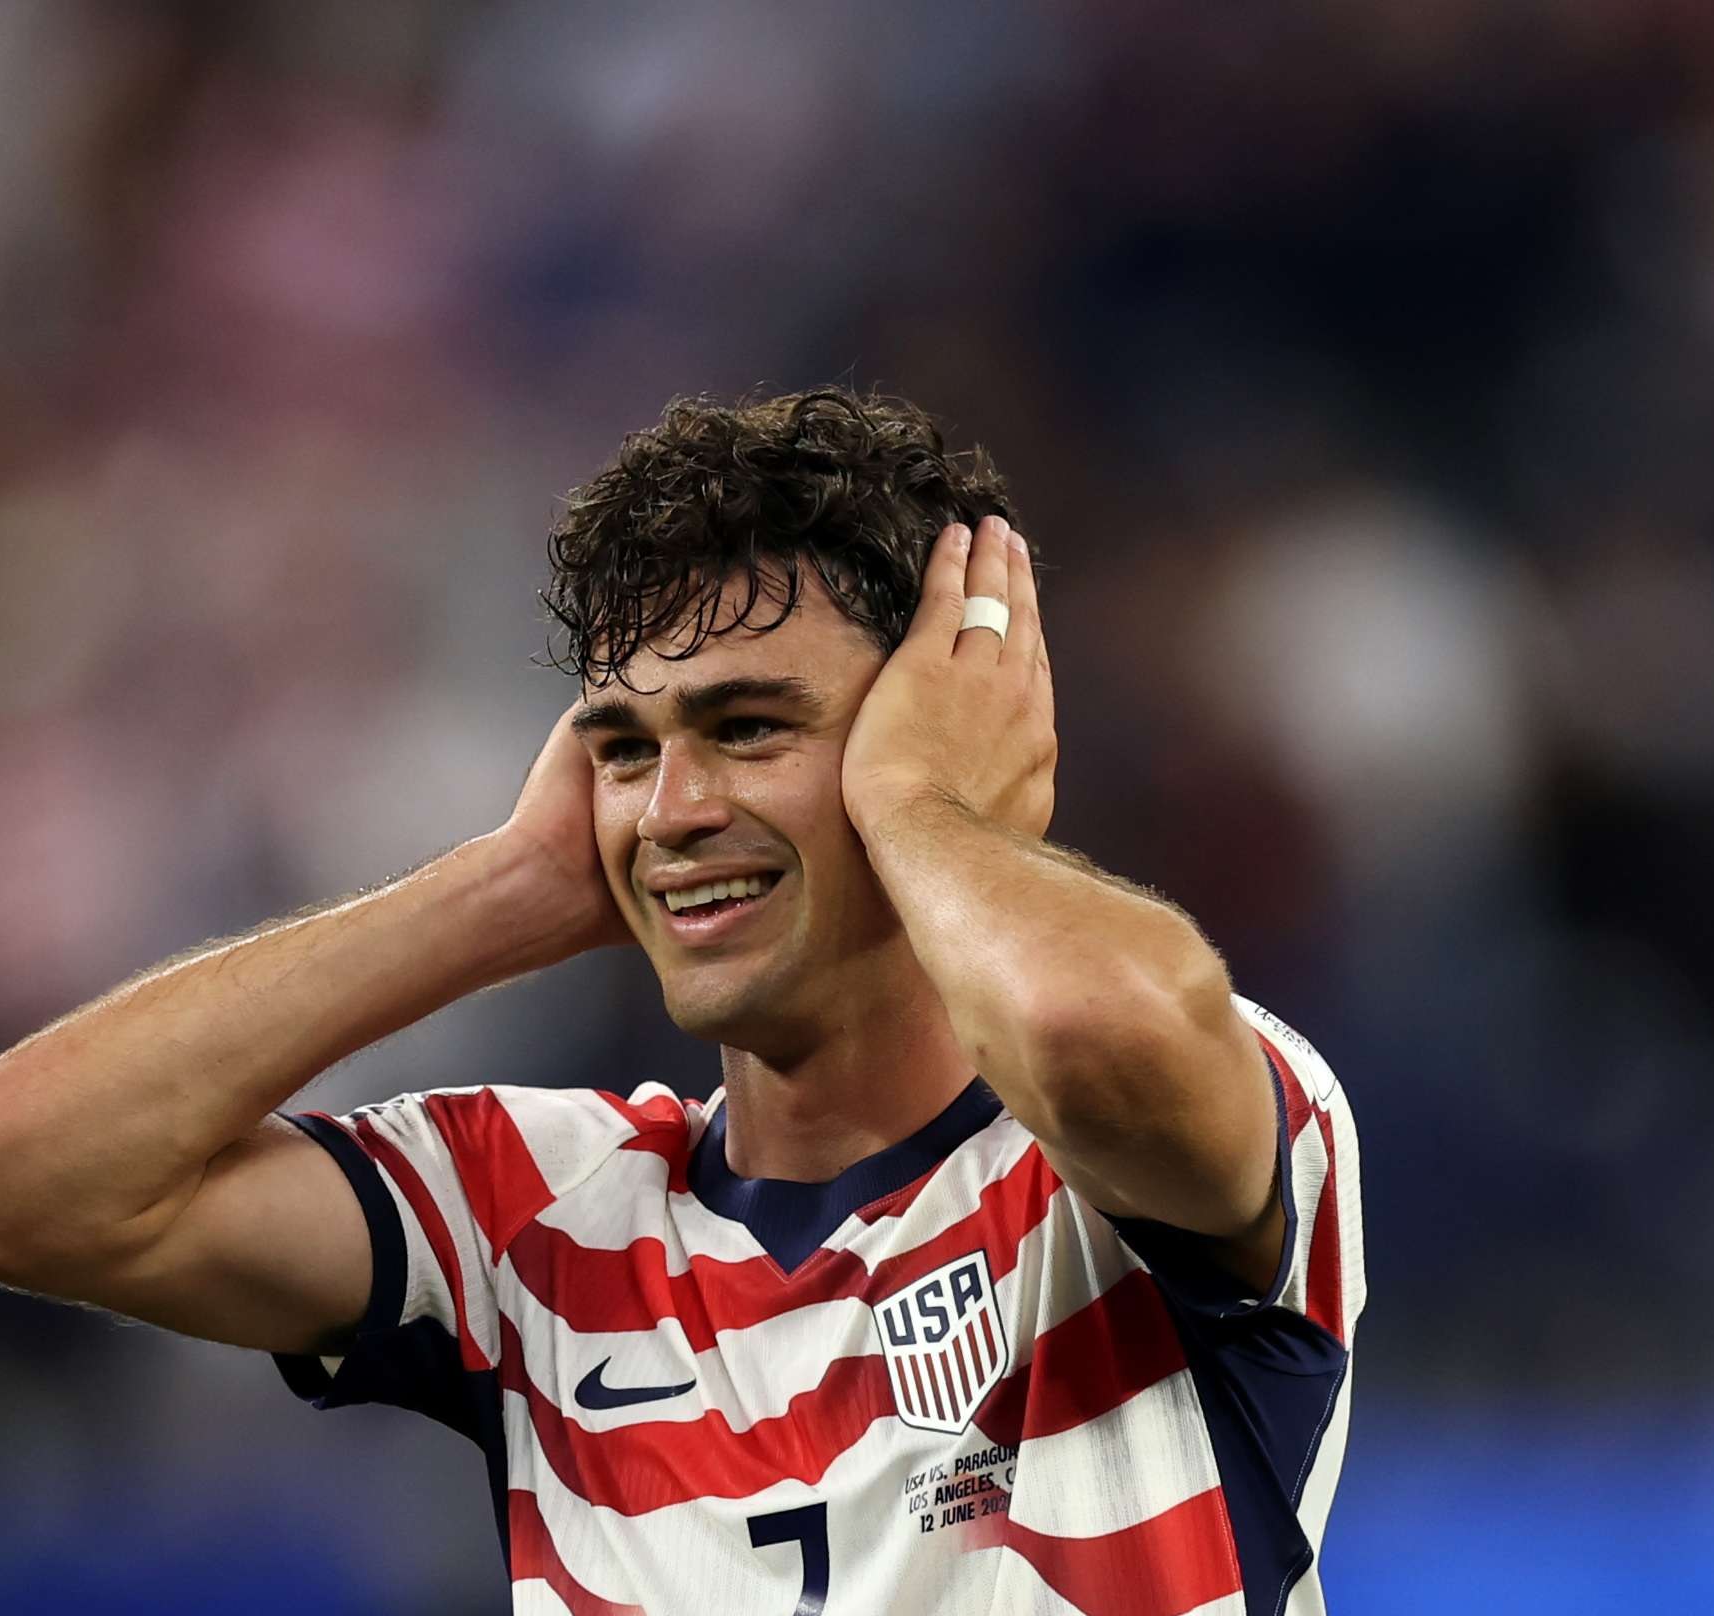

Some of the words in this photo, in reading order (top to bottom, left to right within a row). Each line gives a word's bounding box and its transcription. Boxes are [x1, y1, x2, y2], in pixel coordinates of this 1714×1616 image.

[882, 1262, 984, 1347] USA
[905, 1473, 927, 1494] USA
[929, 1464, 948, 1483] VS.
[954, 1444, 1019, 1476] PARAGUA
[909, 1492, 929, 1514] LOS
[1006, 1465, 1017, 1485] C
[920, 1514, 935, 1533] 12
[940, 1502, 976, 1528] JUNE
